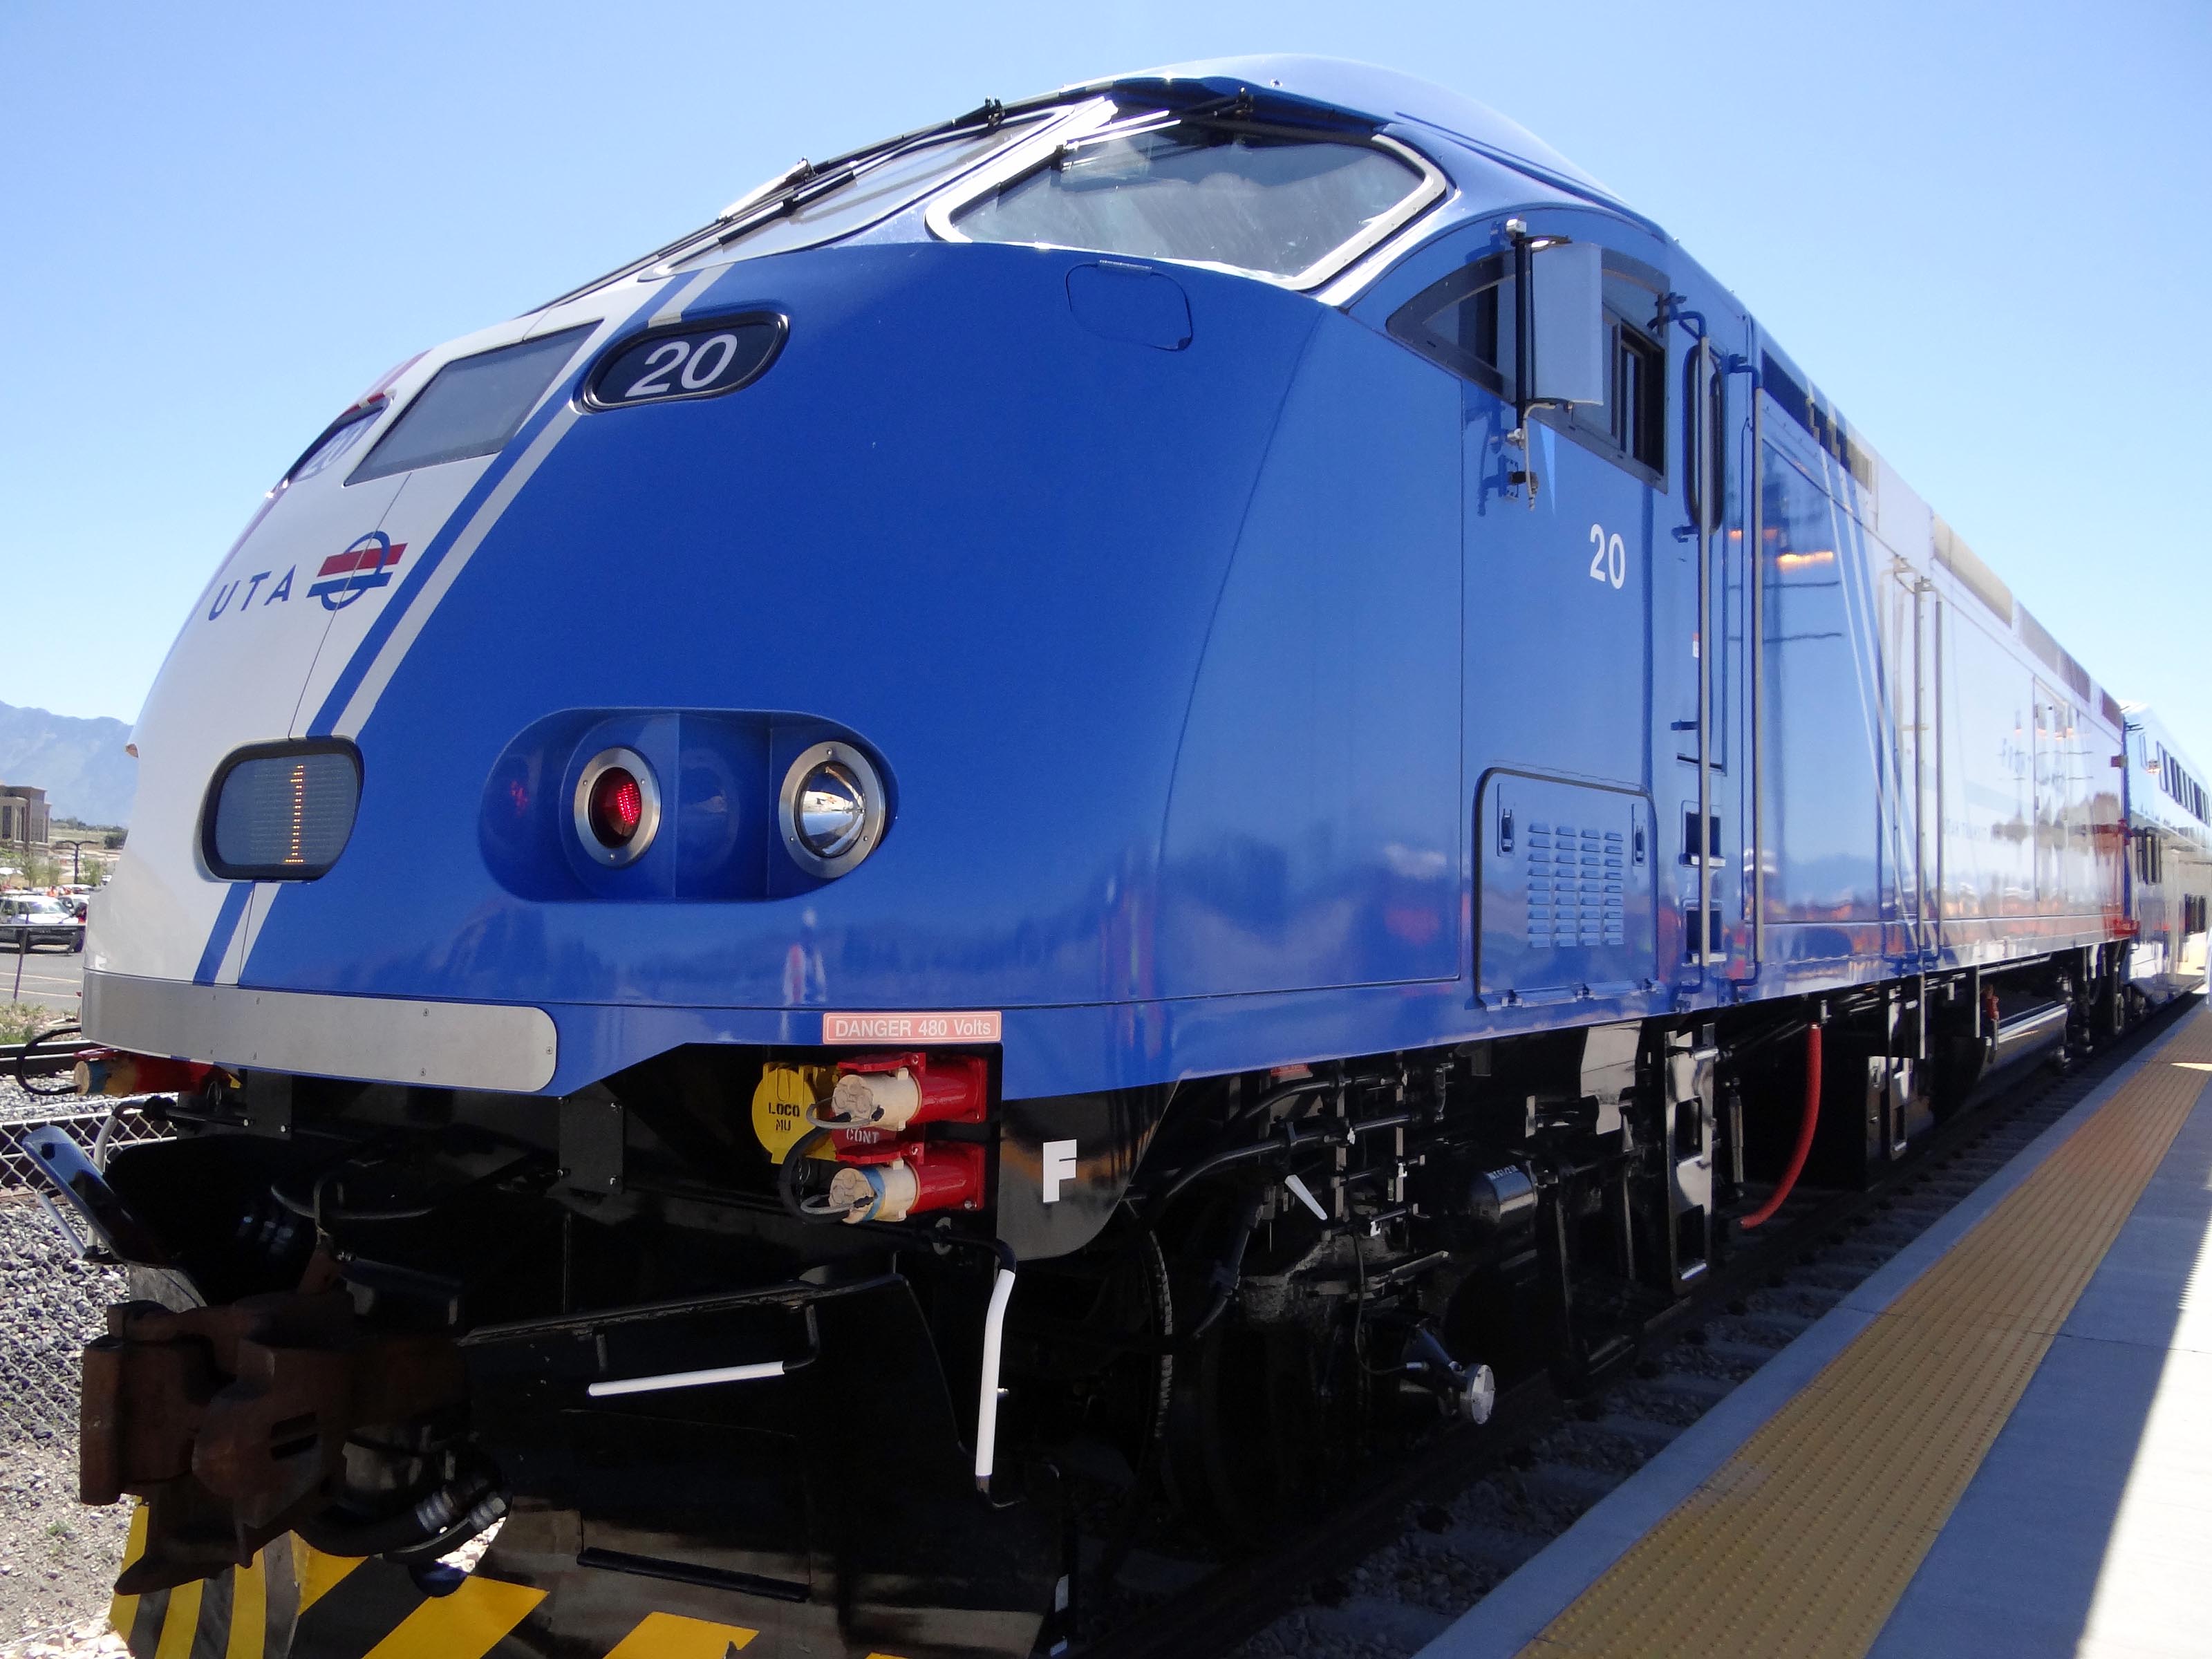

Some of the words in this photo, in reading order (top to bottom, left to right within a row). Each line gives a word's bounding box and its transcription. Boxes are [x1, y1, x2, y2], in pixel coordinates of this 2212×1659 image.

[624, 333, 738, 397] 20
[298, 425, 364, 478] 20
[1590, 523, 1625, 589] 20
[208, 563, 297, 621] UTA
[835, 1020, 912, 1038] DANGER
[918, 1020, 947, 1036] 480
[954, 1019, 991, 1035] Volts
[769, 1102, 800, 1118] LOCO
[776, 1118, 791, 1131] MU
[845, 1127, 880, 1144] CONT
[1042, 1138, 1077, 1203] F
